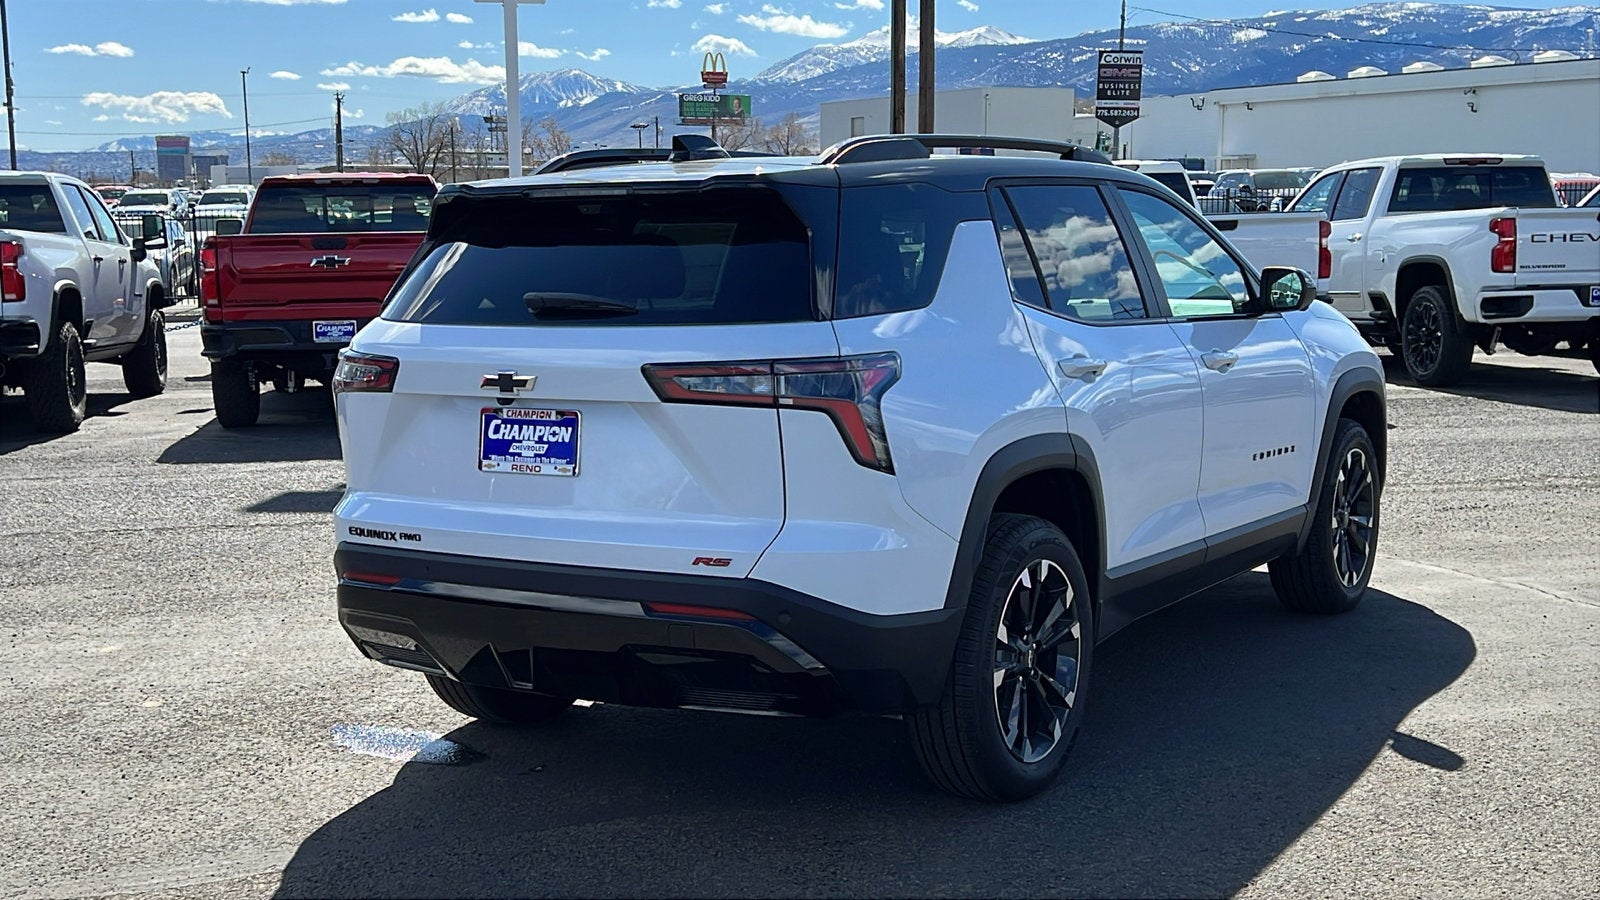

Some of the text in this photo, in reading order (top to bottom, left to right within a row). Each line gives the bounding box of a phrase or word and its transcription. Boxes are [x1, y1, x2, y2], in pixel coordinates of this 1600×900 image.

[1103, 54, 1142, 64] Corwin
[1100, 68, 1140, 77] GMC
[683, 94, 721, 103] GREG KIDD
[1097, 109, 1138, 117] 775.587.2434
[1531, 233, 1600, 243] CHEV
[316, 324, 354, 332] CHAMPION
[506, 409, 552, 420] CHAMPION
[487, 419, 573, 443] CHAMPION
[511, 444, 546, 453] CHEVROLET
[511, 464, 542, 473] RENO
[348, 526, 422, 542] EQUINOX AWD
[691, 556, 733, 567] RS
